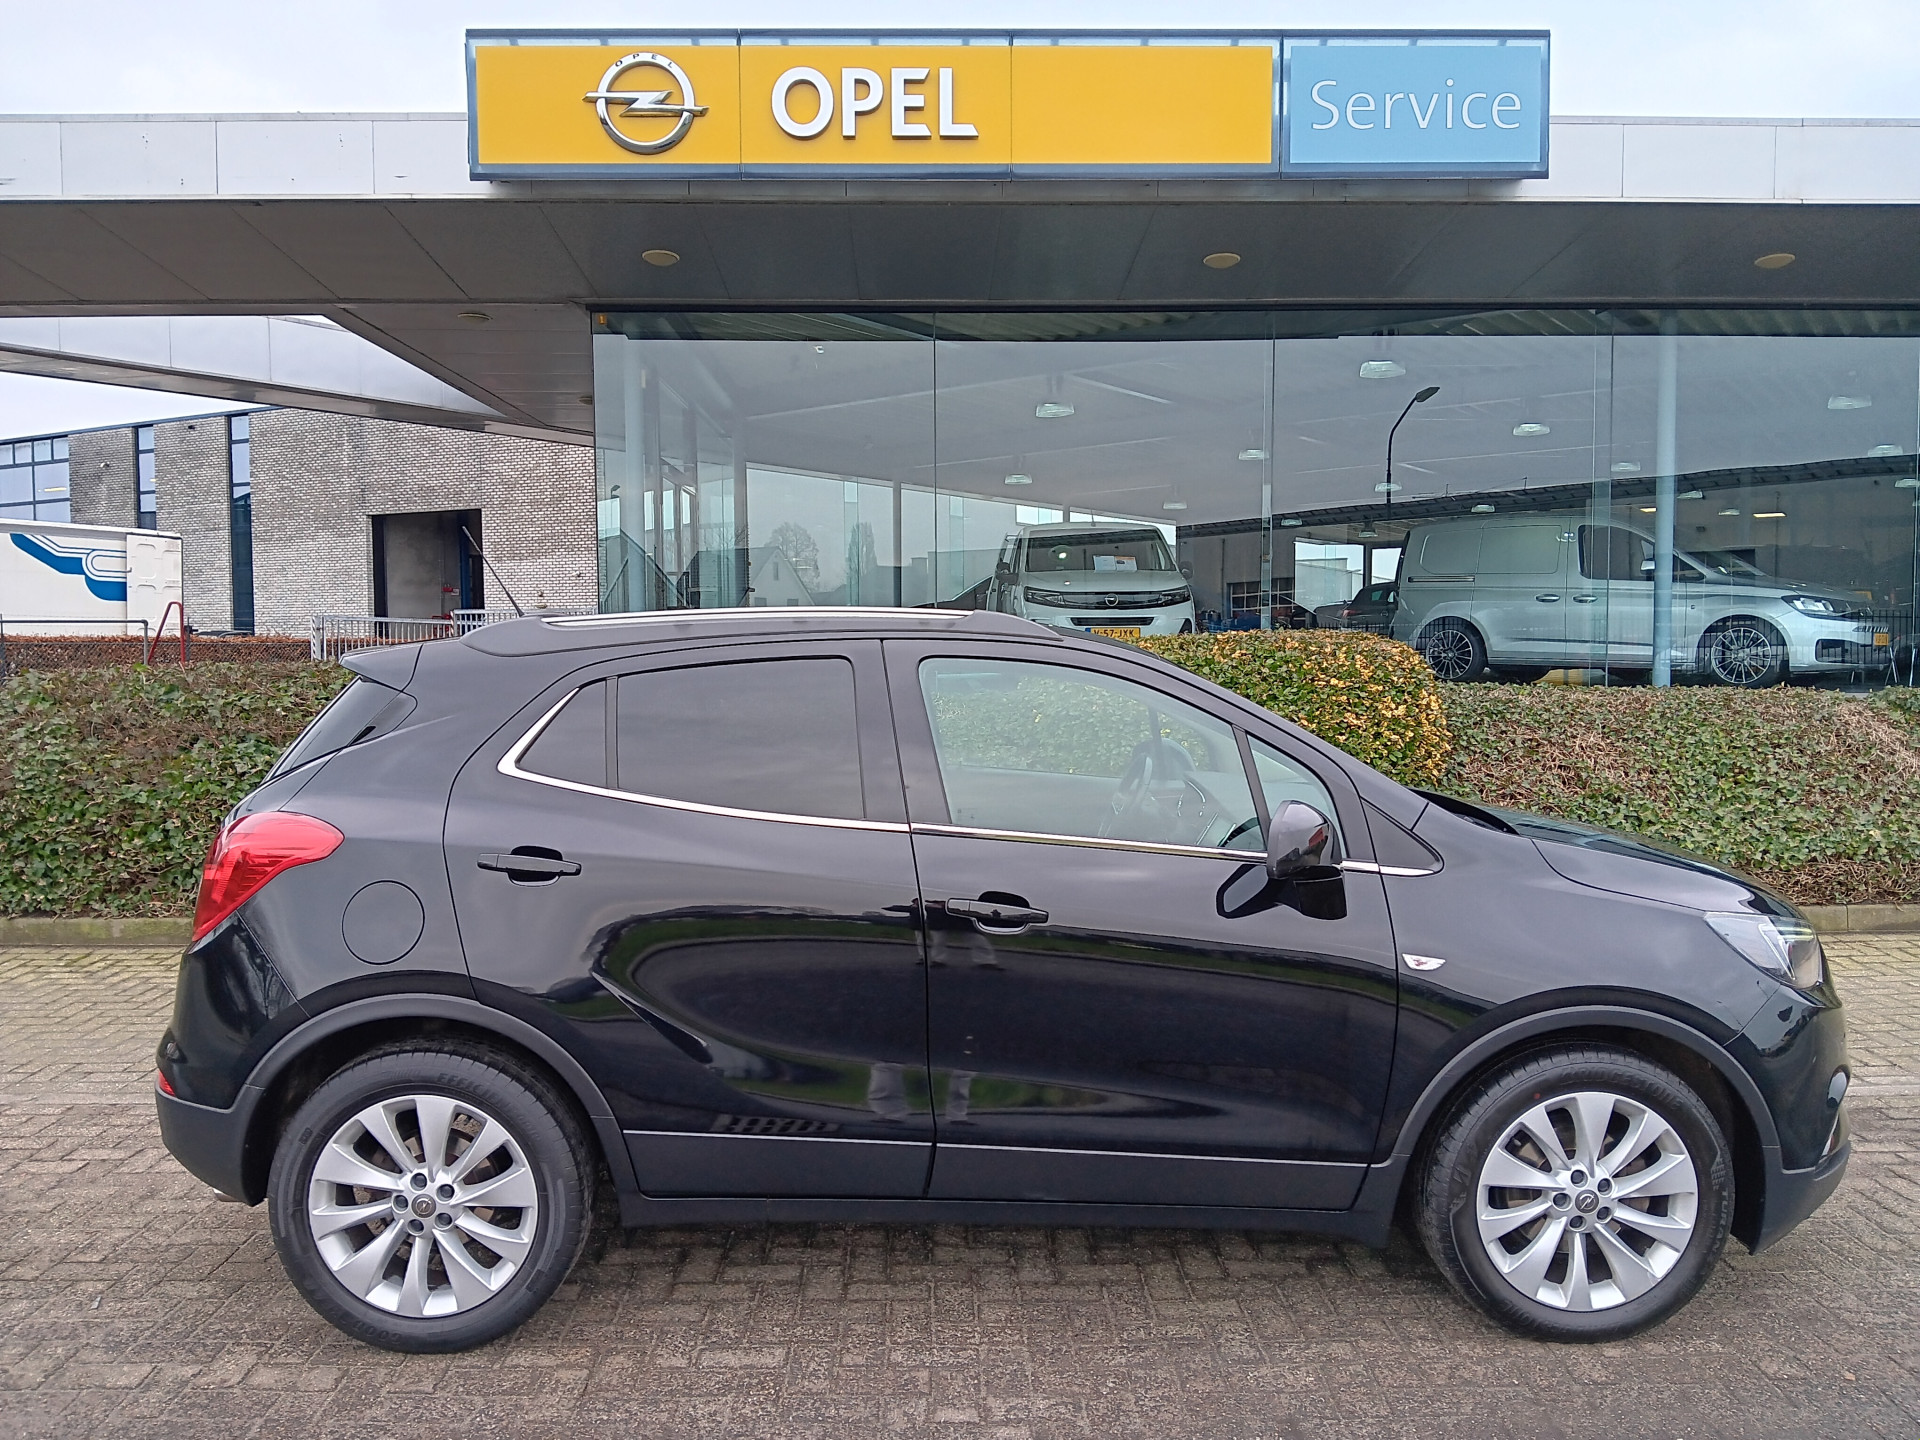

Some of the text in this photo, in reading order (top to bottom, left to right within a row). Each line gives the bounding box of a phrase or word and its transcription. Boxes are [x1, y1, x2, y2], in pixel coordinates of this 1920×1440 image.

[614, 53, 674, 69] OPEL
[771, 66, 979, 140] OPEL
[1310, 77, 1522, 130] Service
